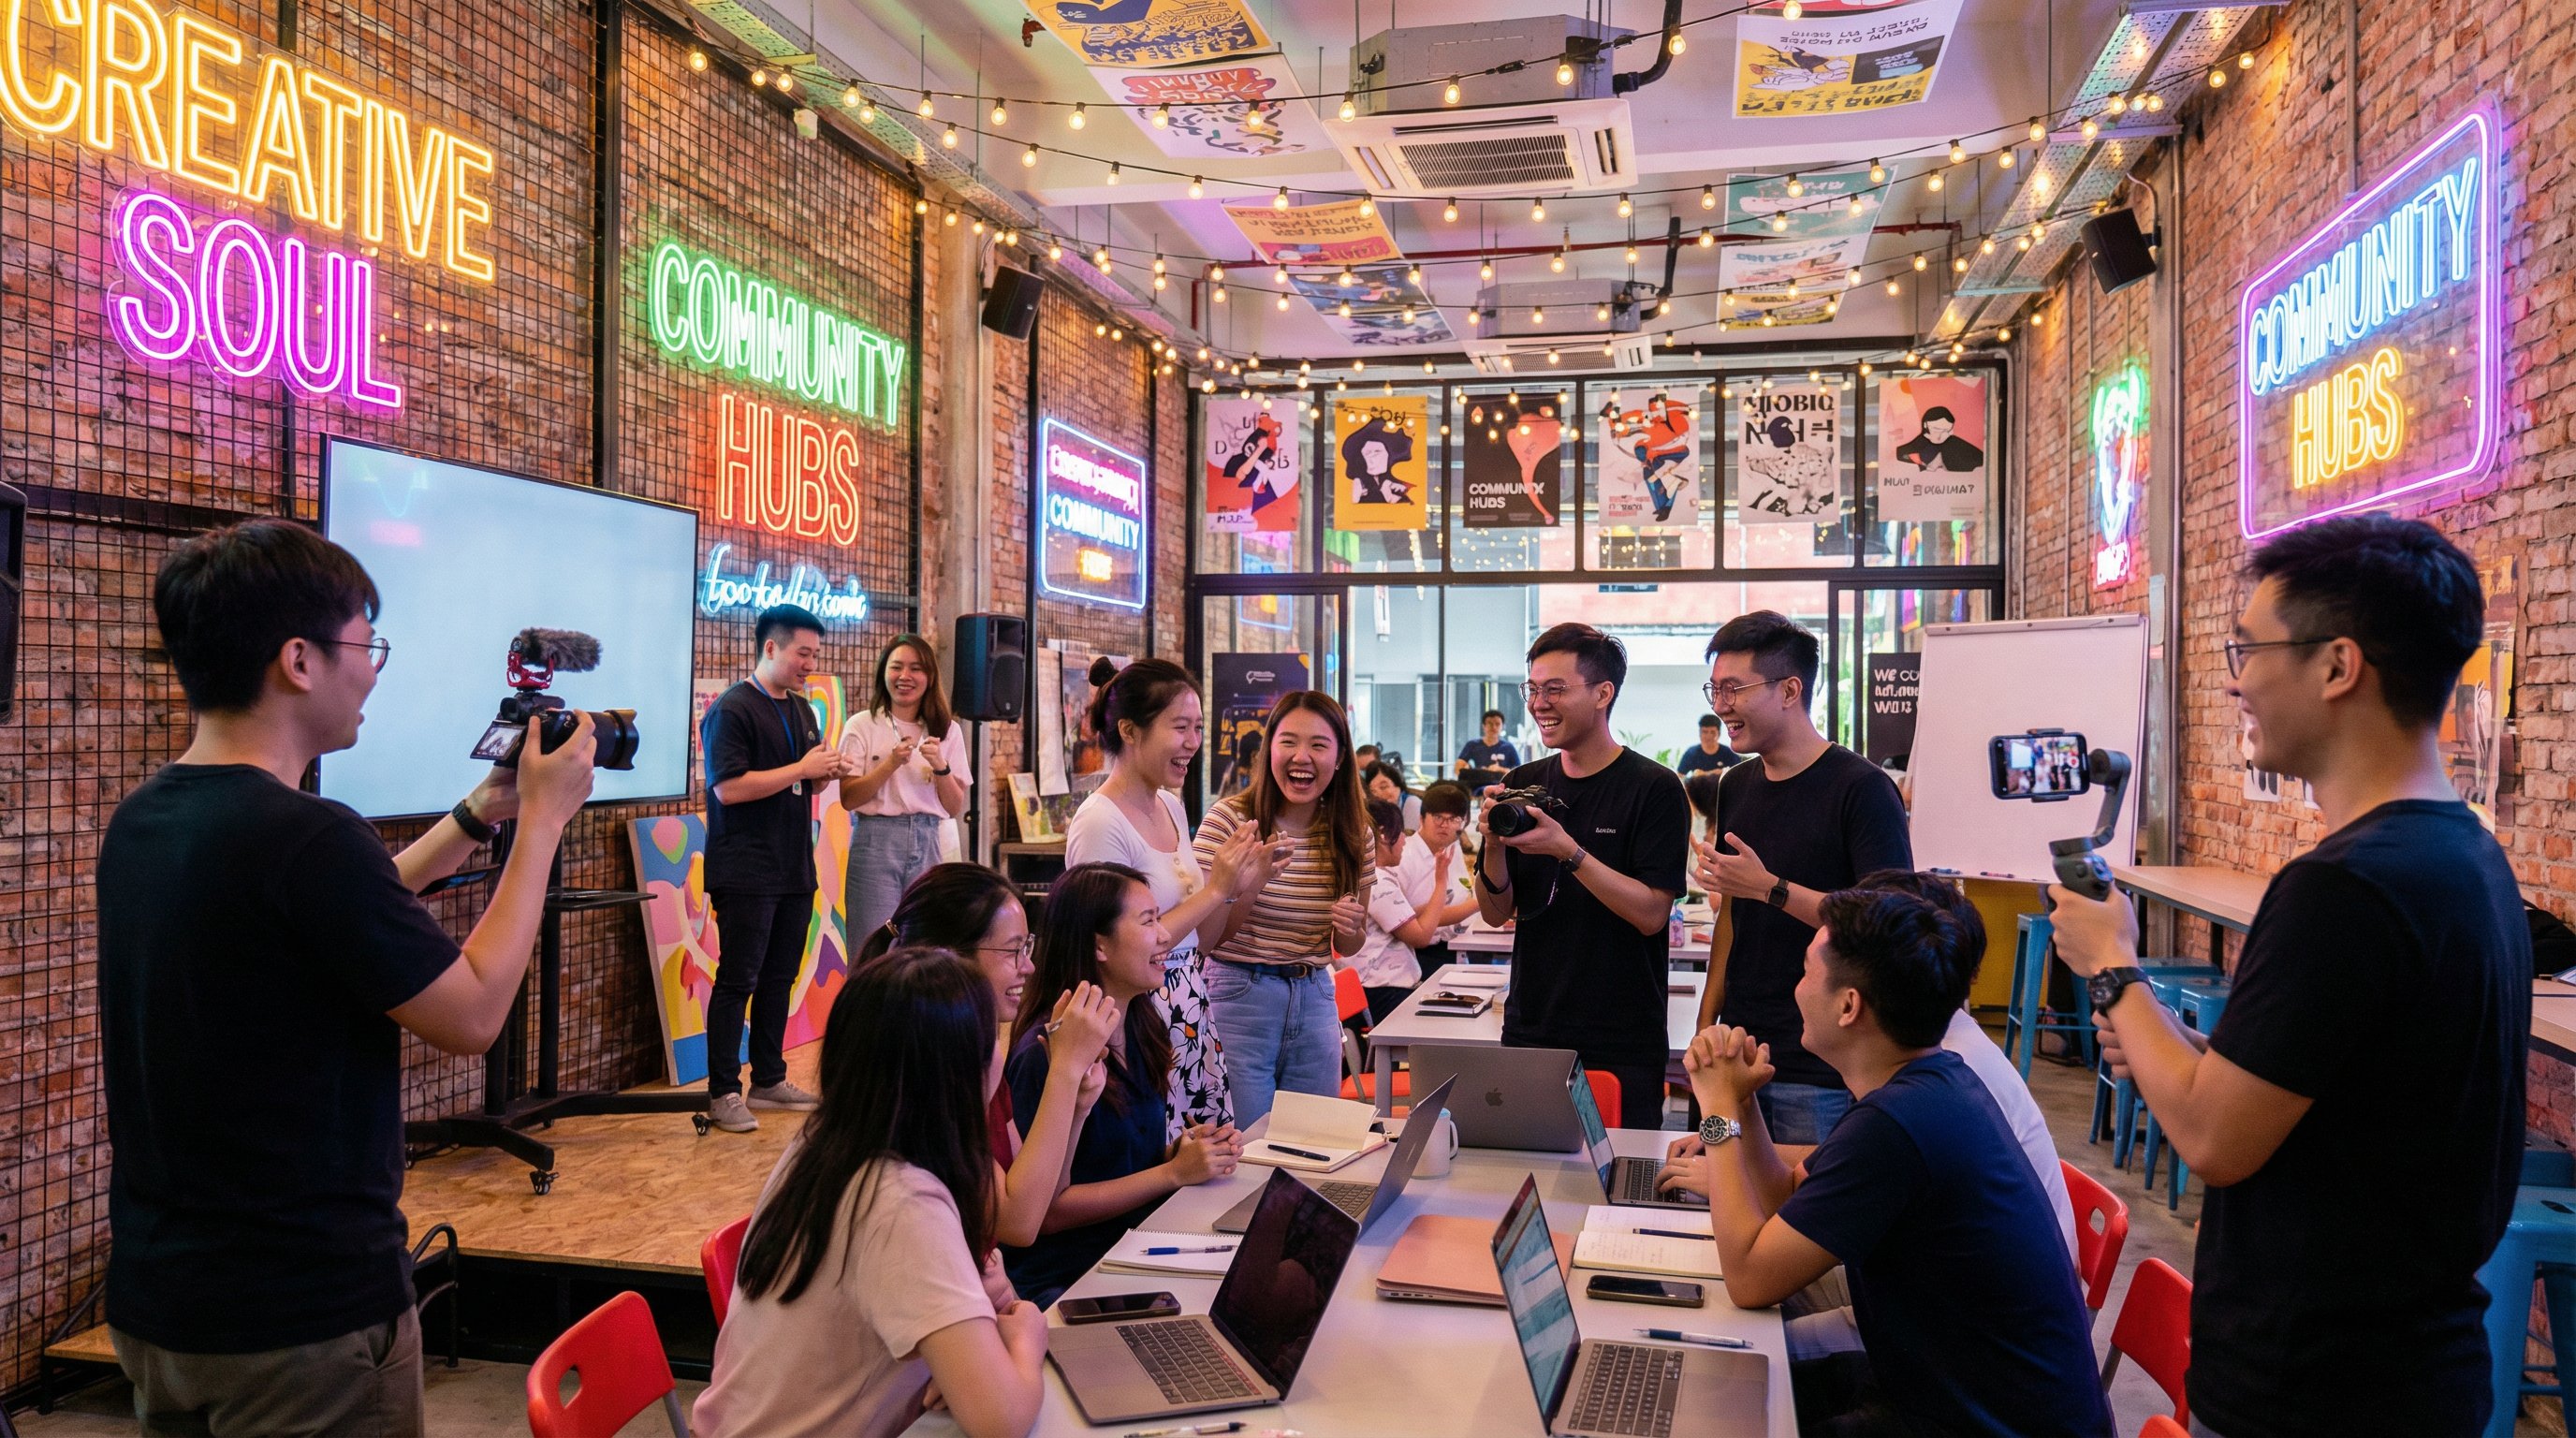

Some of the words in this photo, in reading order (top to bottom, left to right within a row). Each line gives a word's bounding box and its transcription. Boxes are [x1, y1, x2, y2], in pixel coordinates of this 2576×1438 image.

[0, 0, 494, 281] CREATIVE
[119, 193, 402, 408] SOUL
[652, 242, 905, 426] COMMUNITY
[2247, 157, 2479, 395] COMMUNITY
[720, 394, 859, 546] HUBS
[2293, 346, 2402, 490] HUBS
[1049, 493, 1140, 550] COMMUNITY
